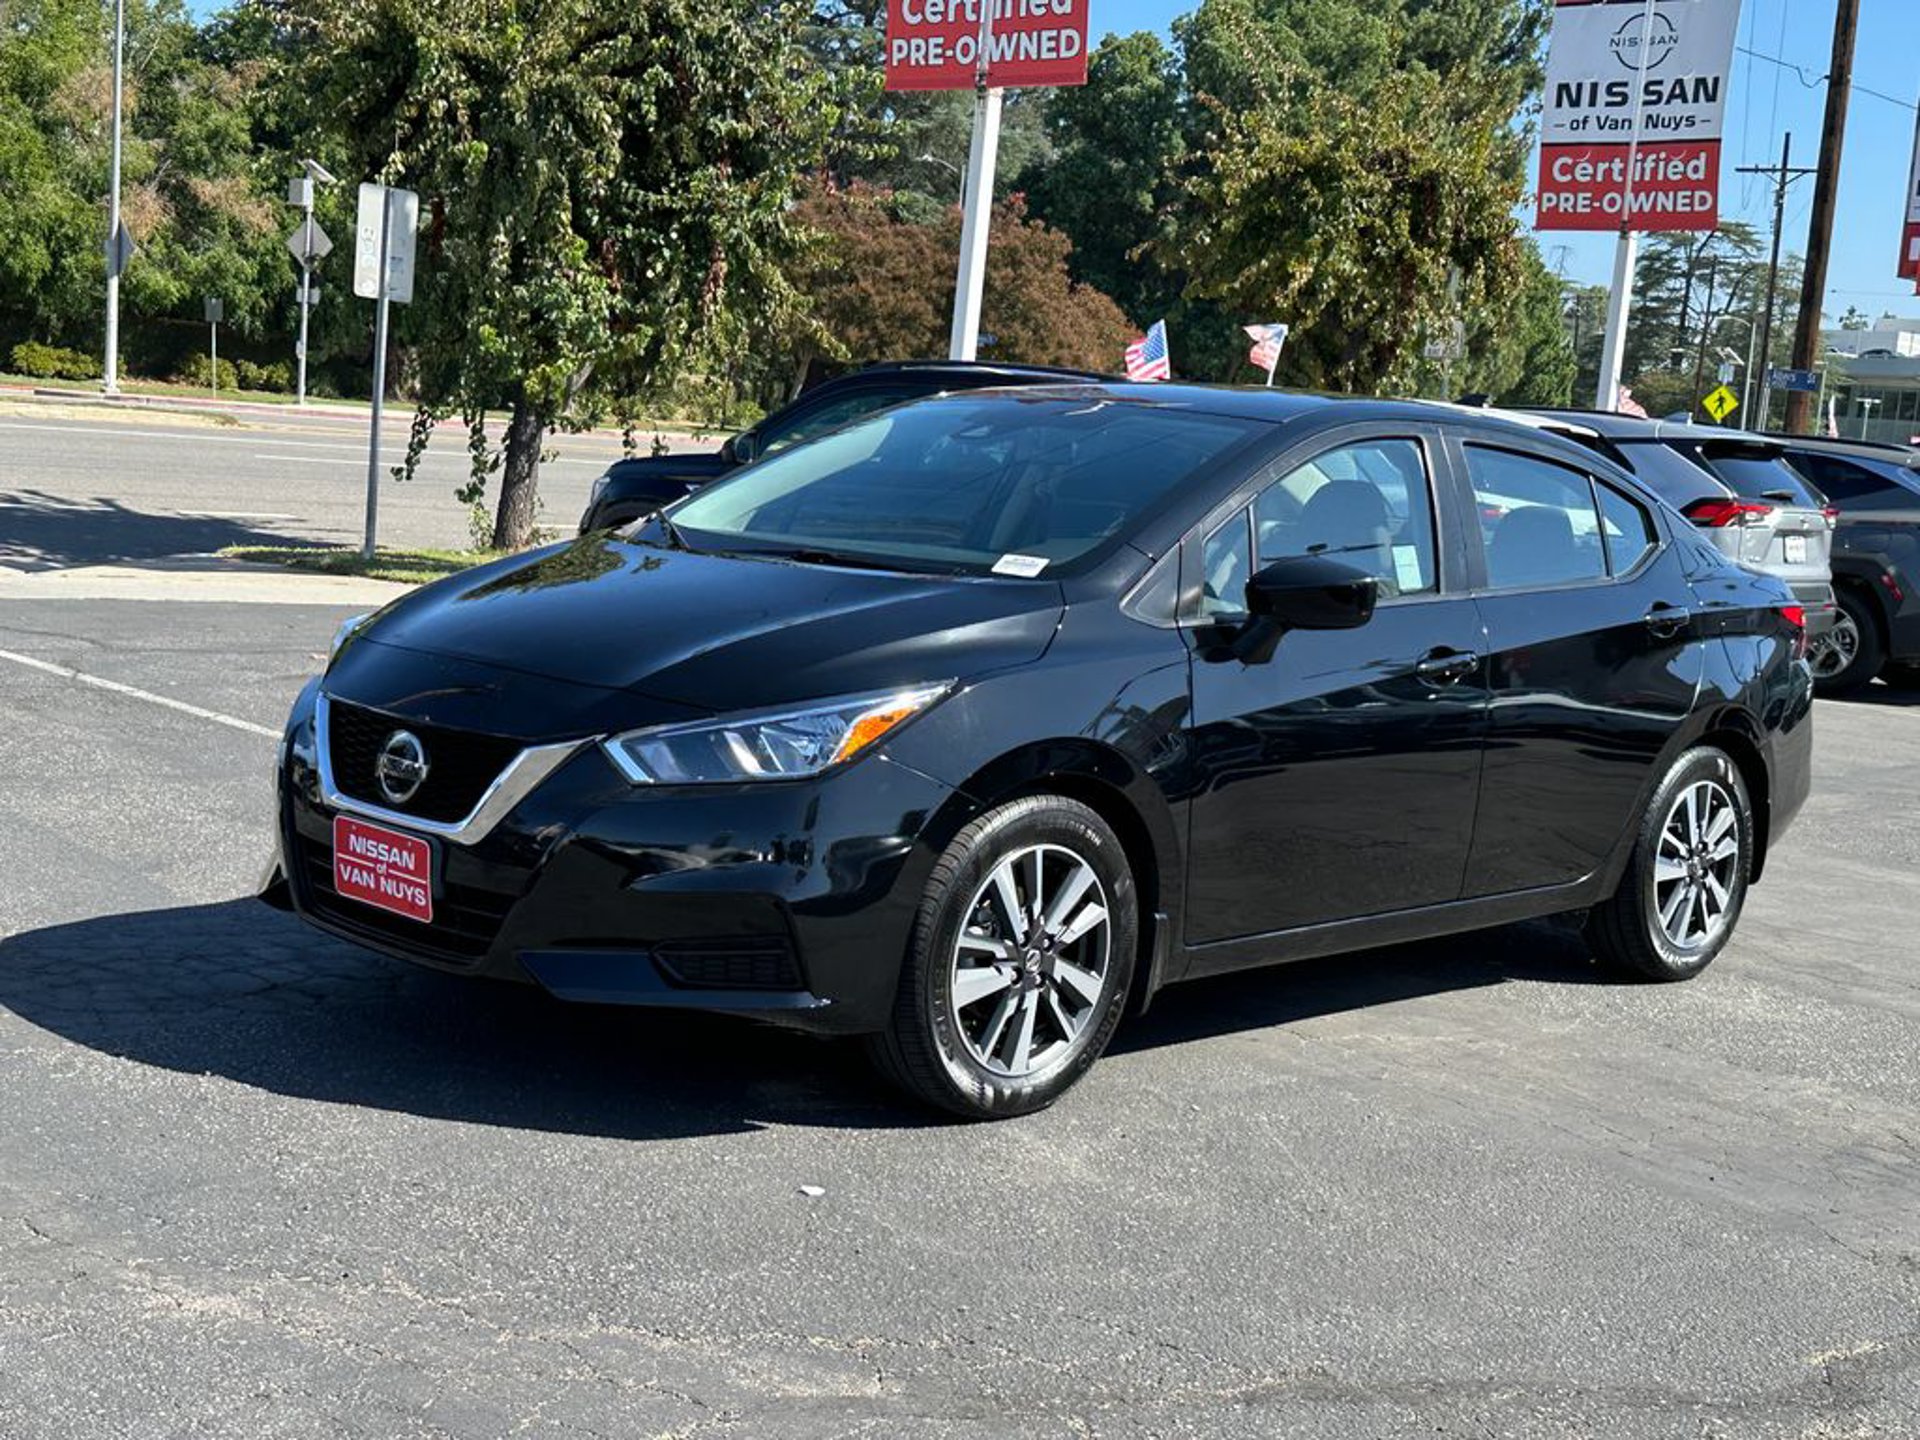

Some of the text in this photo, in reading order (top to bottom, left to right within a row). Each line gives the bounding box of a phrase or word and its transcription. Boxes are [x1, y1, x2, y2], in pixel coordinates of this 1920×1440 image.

[891, 28, 1081, 67] PRE-OWNED
[1609, 36, 1679, 48] NISSAN
[1555, 76, 1720, 108] NISSAN
[1595, 115, 1632, 131] Van
[1552, 151, 1708, 183] Certified
[1541, 190, 1713, 214] PRE-OWNED
[349, 834, 416, 871] NISSAN
[376, 862, 388, 875] of
[339, 863, 427, 906] VAN NUYS
